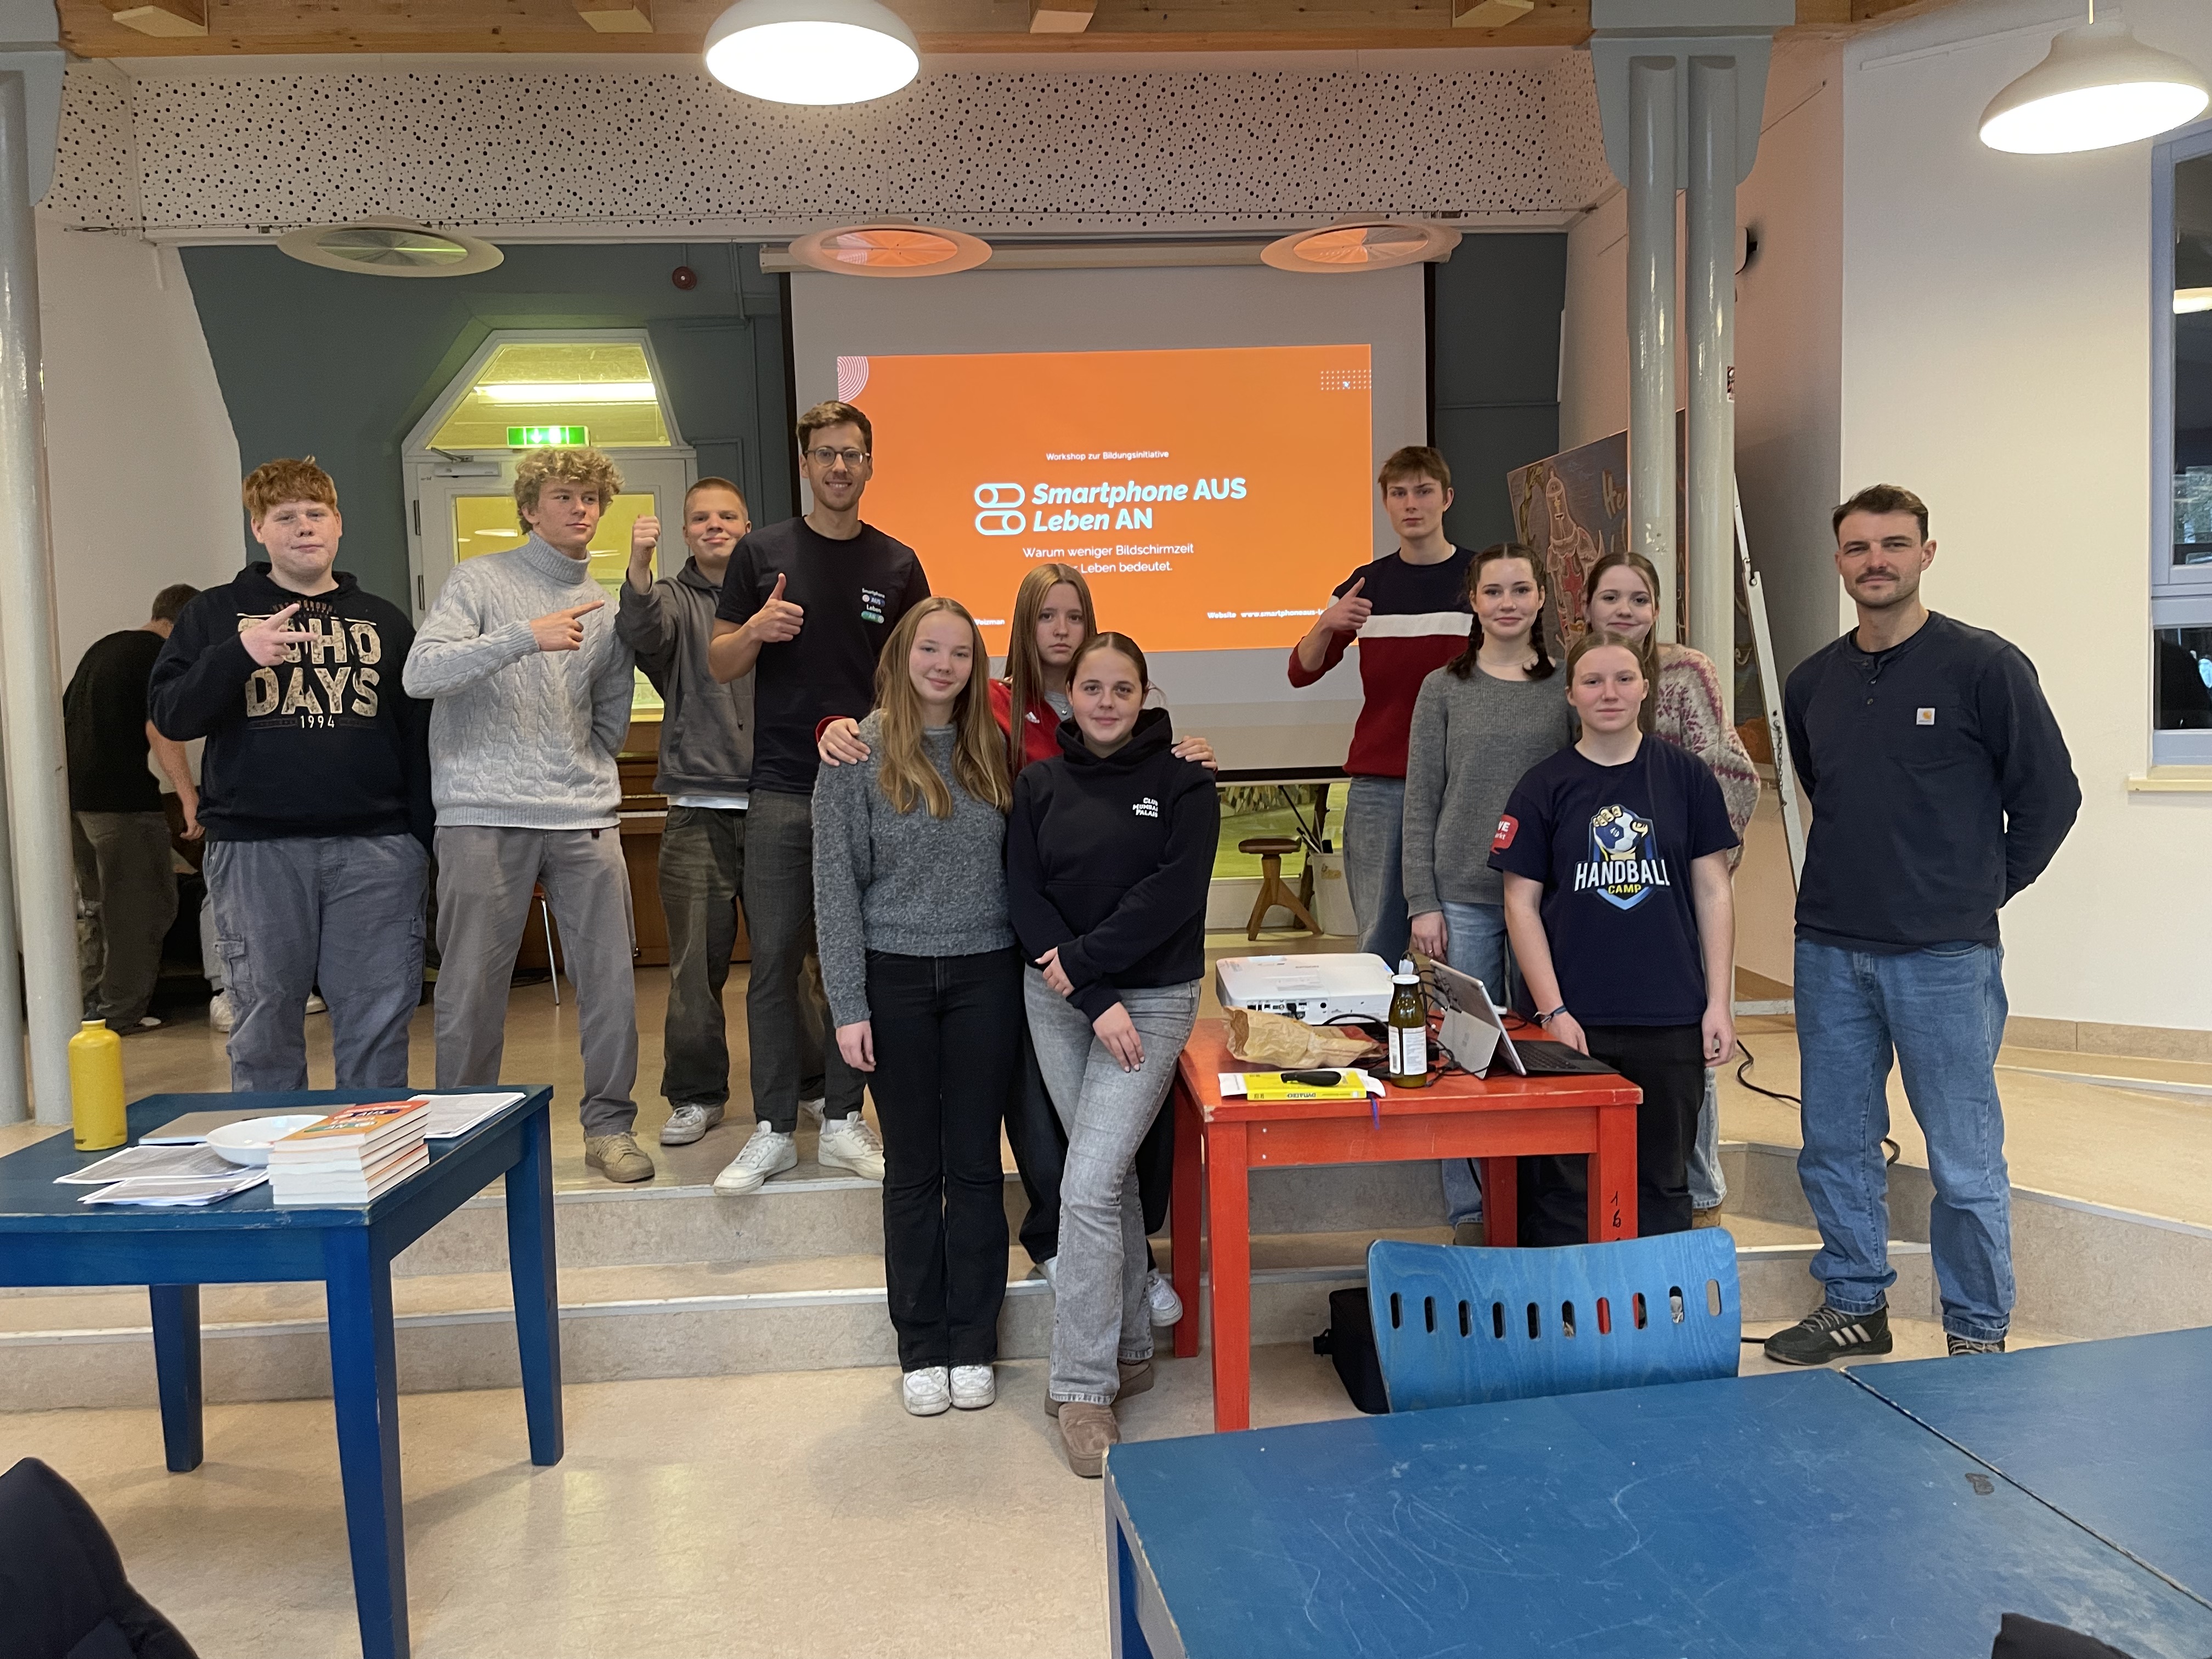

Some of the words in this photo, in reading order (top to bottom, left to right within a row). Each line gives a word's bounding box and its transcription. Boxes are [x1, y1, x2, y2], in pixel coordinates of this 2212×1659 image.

[1046, 453, 1086, 461] Workshop
[1103, 450, 1170, 461] Bildungsinitiative
[1031, 481, 1188, 508] Smartphone
[1193, 477, 1248, 500] AUS
[1032, 509, 1110, 532] Leben
[1115, 507, 1153, 530] AN
[1022, 548, 1065, 558] Warum
[1067, 545, 1114, 558] weniger
[1116, 543, 1194, 556] Bildschirmzeit
[1081, 562, 1116, 574] Leben
[1119, 561, 1173, 573] bedeutet.
[871, 597, 882, 605] AUS
[866, 604, 882, 613] Leben
[245, 667, 380, 717] DAYS
[300, 715, 335, 729] 1994
[1574, 859, 1671, 892] HANDBALL
[1608, 884, 1642, 895] CAMP
